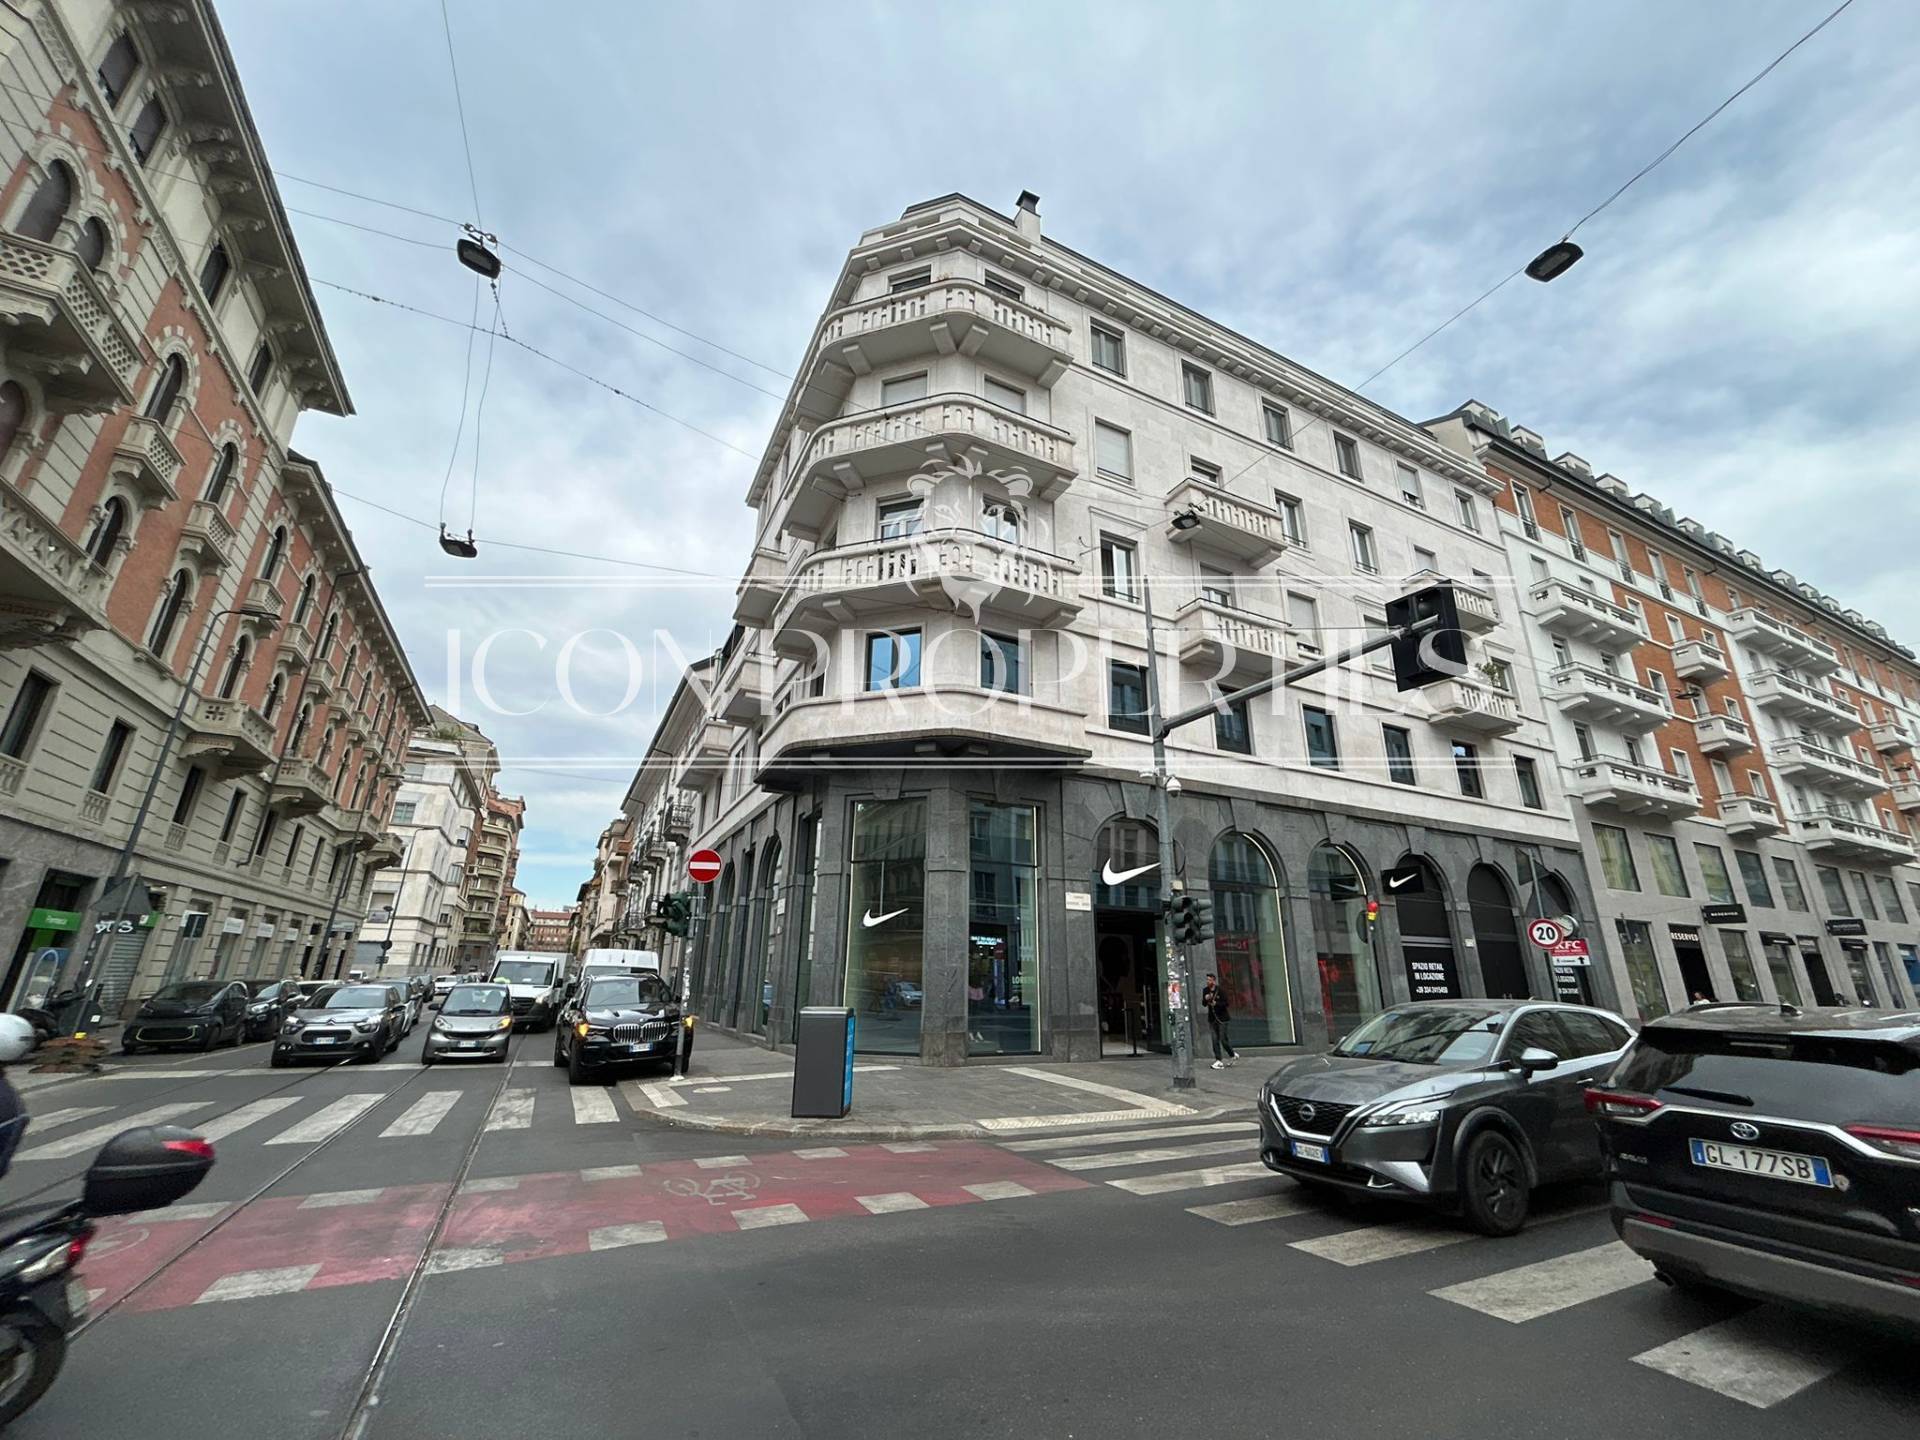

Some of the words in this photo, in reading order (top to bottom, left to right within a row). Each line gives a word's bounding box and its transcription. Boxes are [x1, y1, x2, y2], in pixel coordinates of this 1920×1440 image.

[1536, 926, 1556, 940] 20
[1670, 932, 1699, 941] RESERVED
[1411, 962, 1429, 970] SPAZIO
[1428, 962, 1444, 971] RETAIL
[1414, 972, 1420, 980] IN
[1420, 972, 1445, 981] LOCAZIONE
